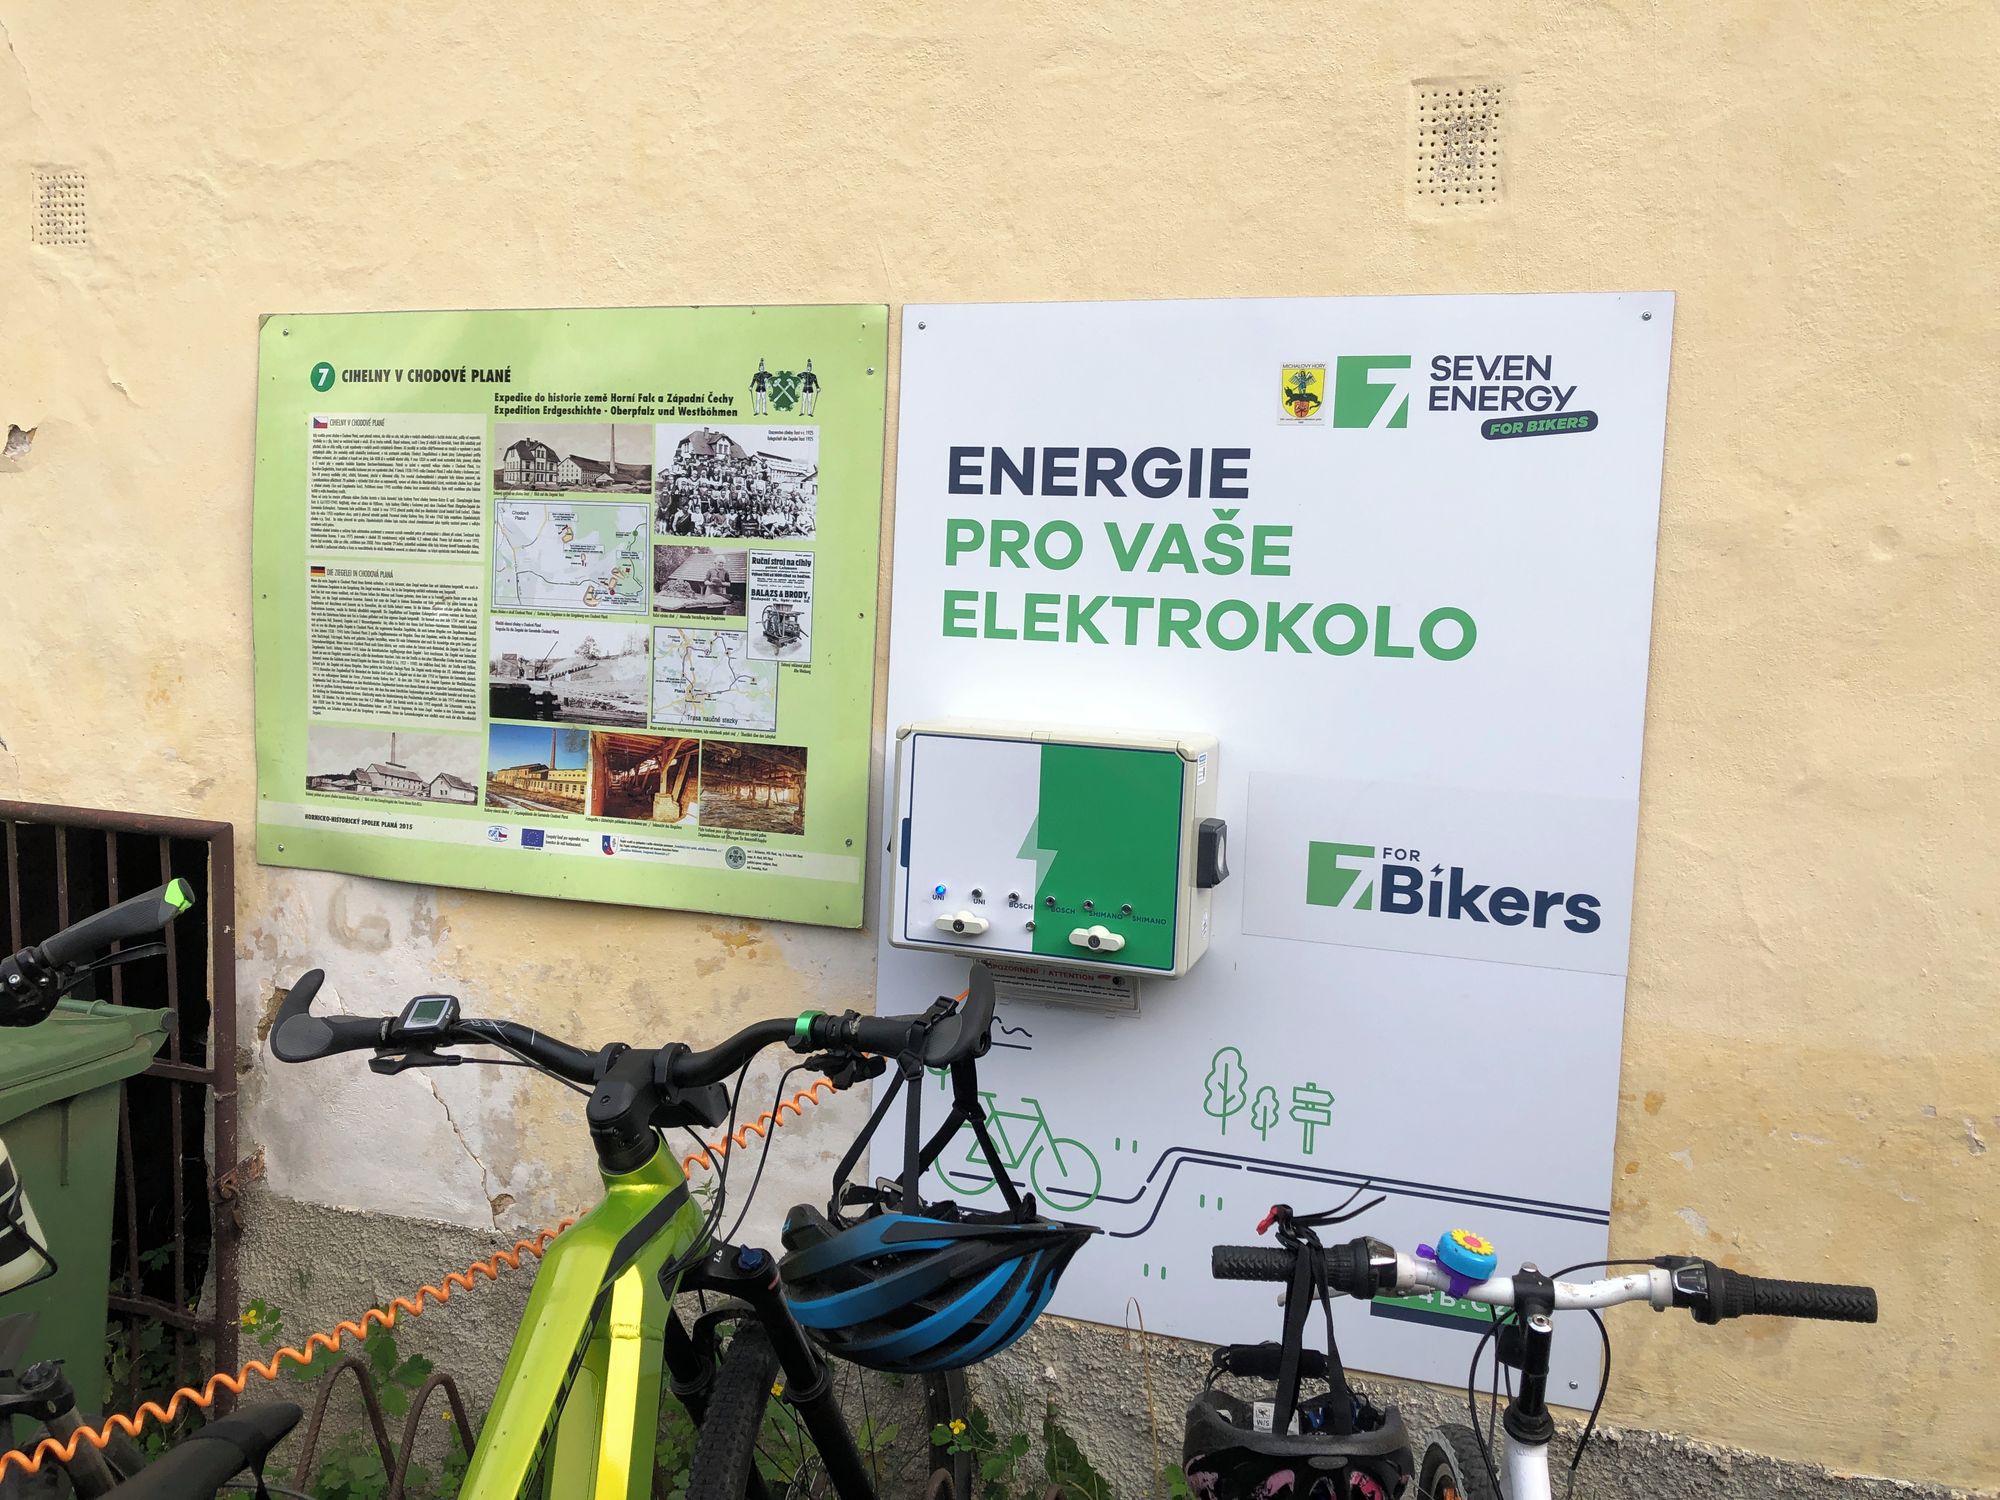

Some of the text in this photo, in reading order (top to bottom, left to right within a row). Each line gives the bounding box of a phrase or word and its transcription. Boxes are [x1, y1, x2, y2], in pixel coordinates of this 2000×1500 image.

[318, 368, 330, 387] 7
[342, 366, 511, 383] CIHELNY V CHODOVÉ PLANÉ
[494, 391, 734, 406] Expedice do historie země Horní Falc a Západní Čechy
[1428, 385, 1578, 411] ENERGY
[494, 405, 540, 417] Expedition
[543, 405, 602, 418] Erdgeschichte
[610, 406, 655, 418] Oberpfalz
[657, 407, 675, 417] und
[678, 407, 738, 417] Westböhmen
[329, 418, 347, 427] CIHELNY
[351, 417, 372, 427] CHODOVÉ
[1489, 415, 1589, 437] FOR BIKERS
[948, 446, 1251, 499] ENERGIE
[945, 508, 1294, 577] PRO VAŠE
[751, 556, 770, 565] Ruční
[771, 557, 786, 566] stroj
[795, 559, 812, 568] cihly
[751, 588, 811, 600] BALAZS & BRODY,
[942, 590, 1478, 662] ELEKTROKOLO
[687, 714, 738, 725] Trasa naučné stezky
[304, 813, 360, 825] HORNICKO-HISTORICKÝ
[361, 819, 380, 827] SPOLEK
[381, 820, 398, 829] PLANÁ
[1383, 847, 1421, 863] FOR
[931, 894, 945, 902] UNI
[973, 898, 986, 906] UNI
[1379, 863, 1602, 934] Bikers
[1008, 901, 1033, 911] BOSCH
[1051, 905, 1076, 915] BOSCH
[1089, 910, 1123, 921] SHIMANO
[1132, 914, 1167, 926] SHIMANO
[1048, 970, 1095, 981] ATTENTION
